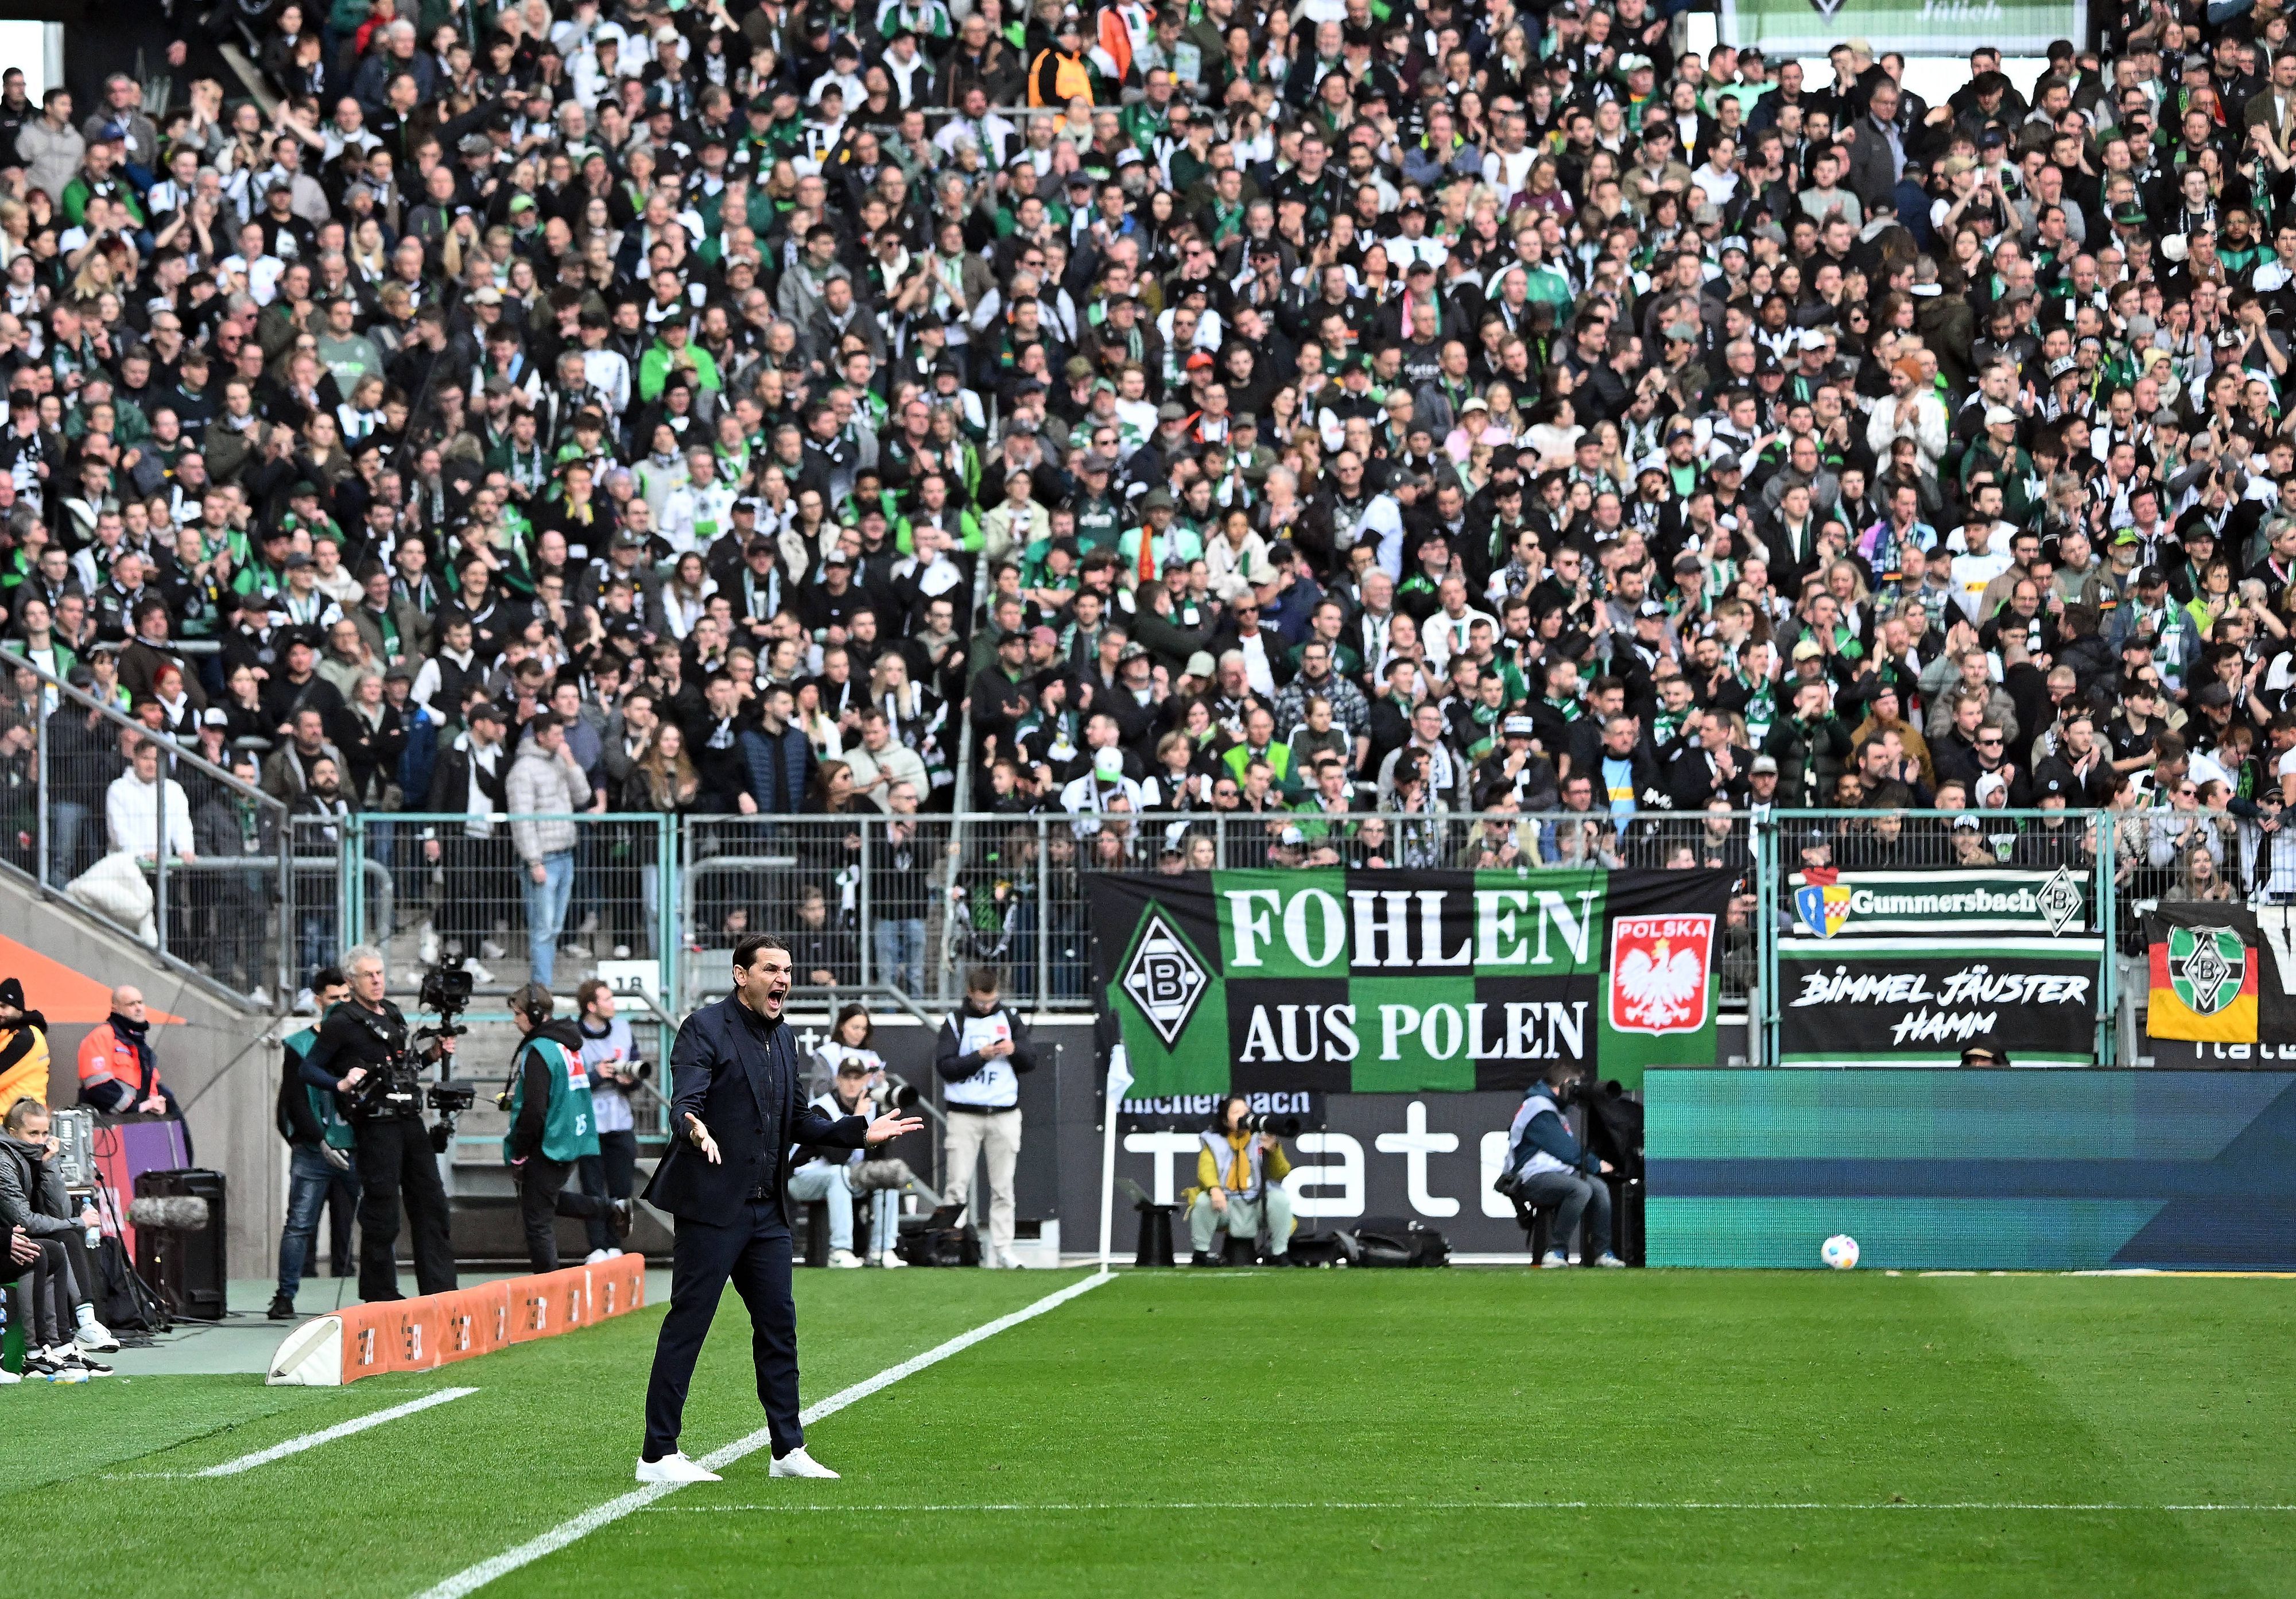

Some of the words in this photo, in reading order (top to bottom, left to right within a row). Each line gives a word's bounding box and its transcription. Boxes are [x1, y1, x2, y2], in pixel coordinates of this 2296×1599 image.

[1851, 888, 2037, 914] Gummersbach
[1224, 888, 1600, 967] FOHLEN
[1618, 920, 1707, 939] POLSKA
[1937, 964, 2090, 1006] JÄUSTER
[1239, 1004, 1360, 1062] AUS
[1378, 1001, 1588, 1060] POLEN
[1890, 1005, 1998, 1046] HAMM
